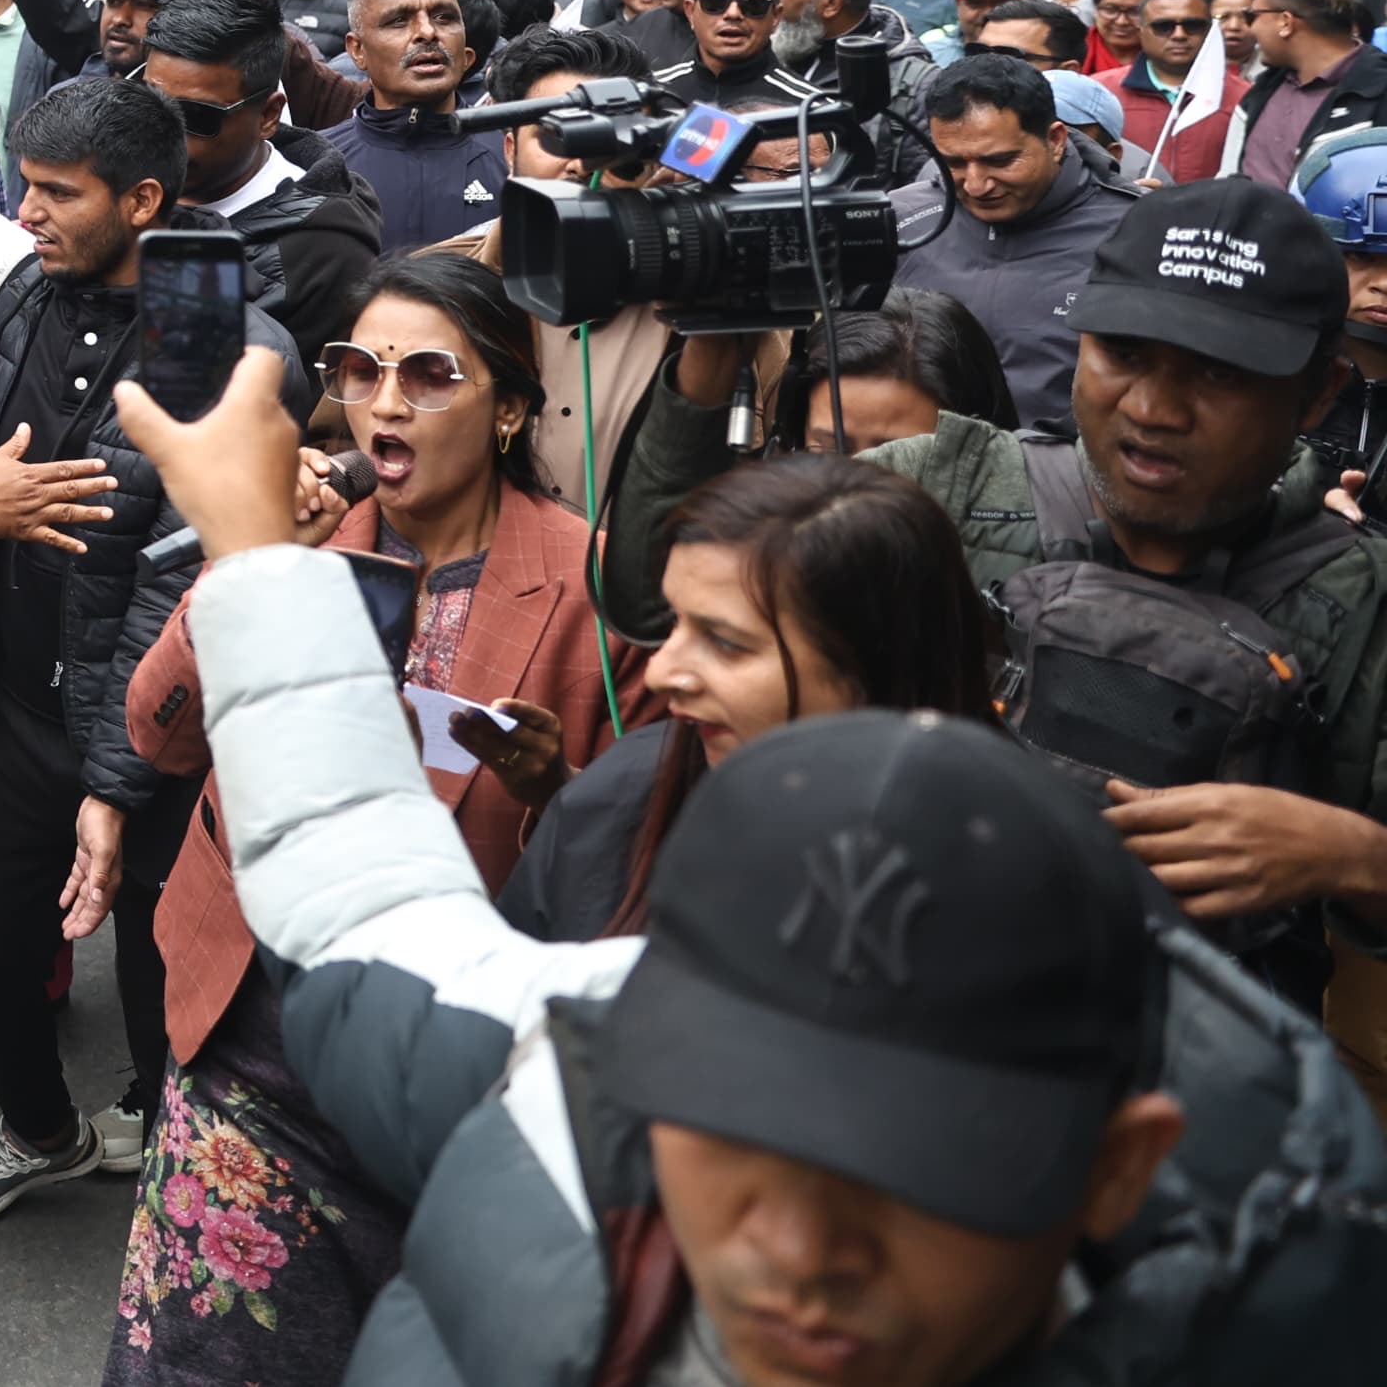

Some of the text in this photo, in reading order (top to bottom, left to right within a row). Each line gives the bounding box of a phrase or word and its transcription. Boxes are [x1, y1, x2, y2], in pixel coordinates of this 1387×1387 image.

[846, 209, 880, 219] SONY
[1158, 259, 1244, 289] Campus
[1161, 243, 1266, 276] Innovation
